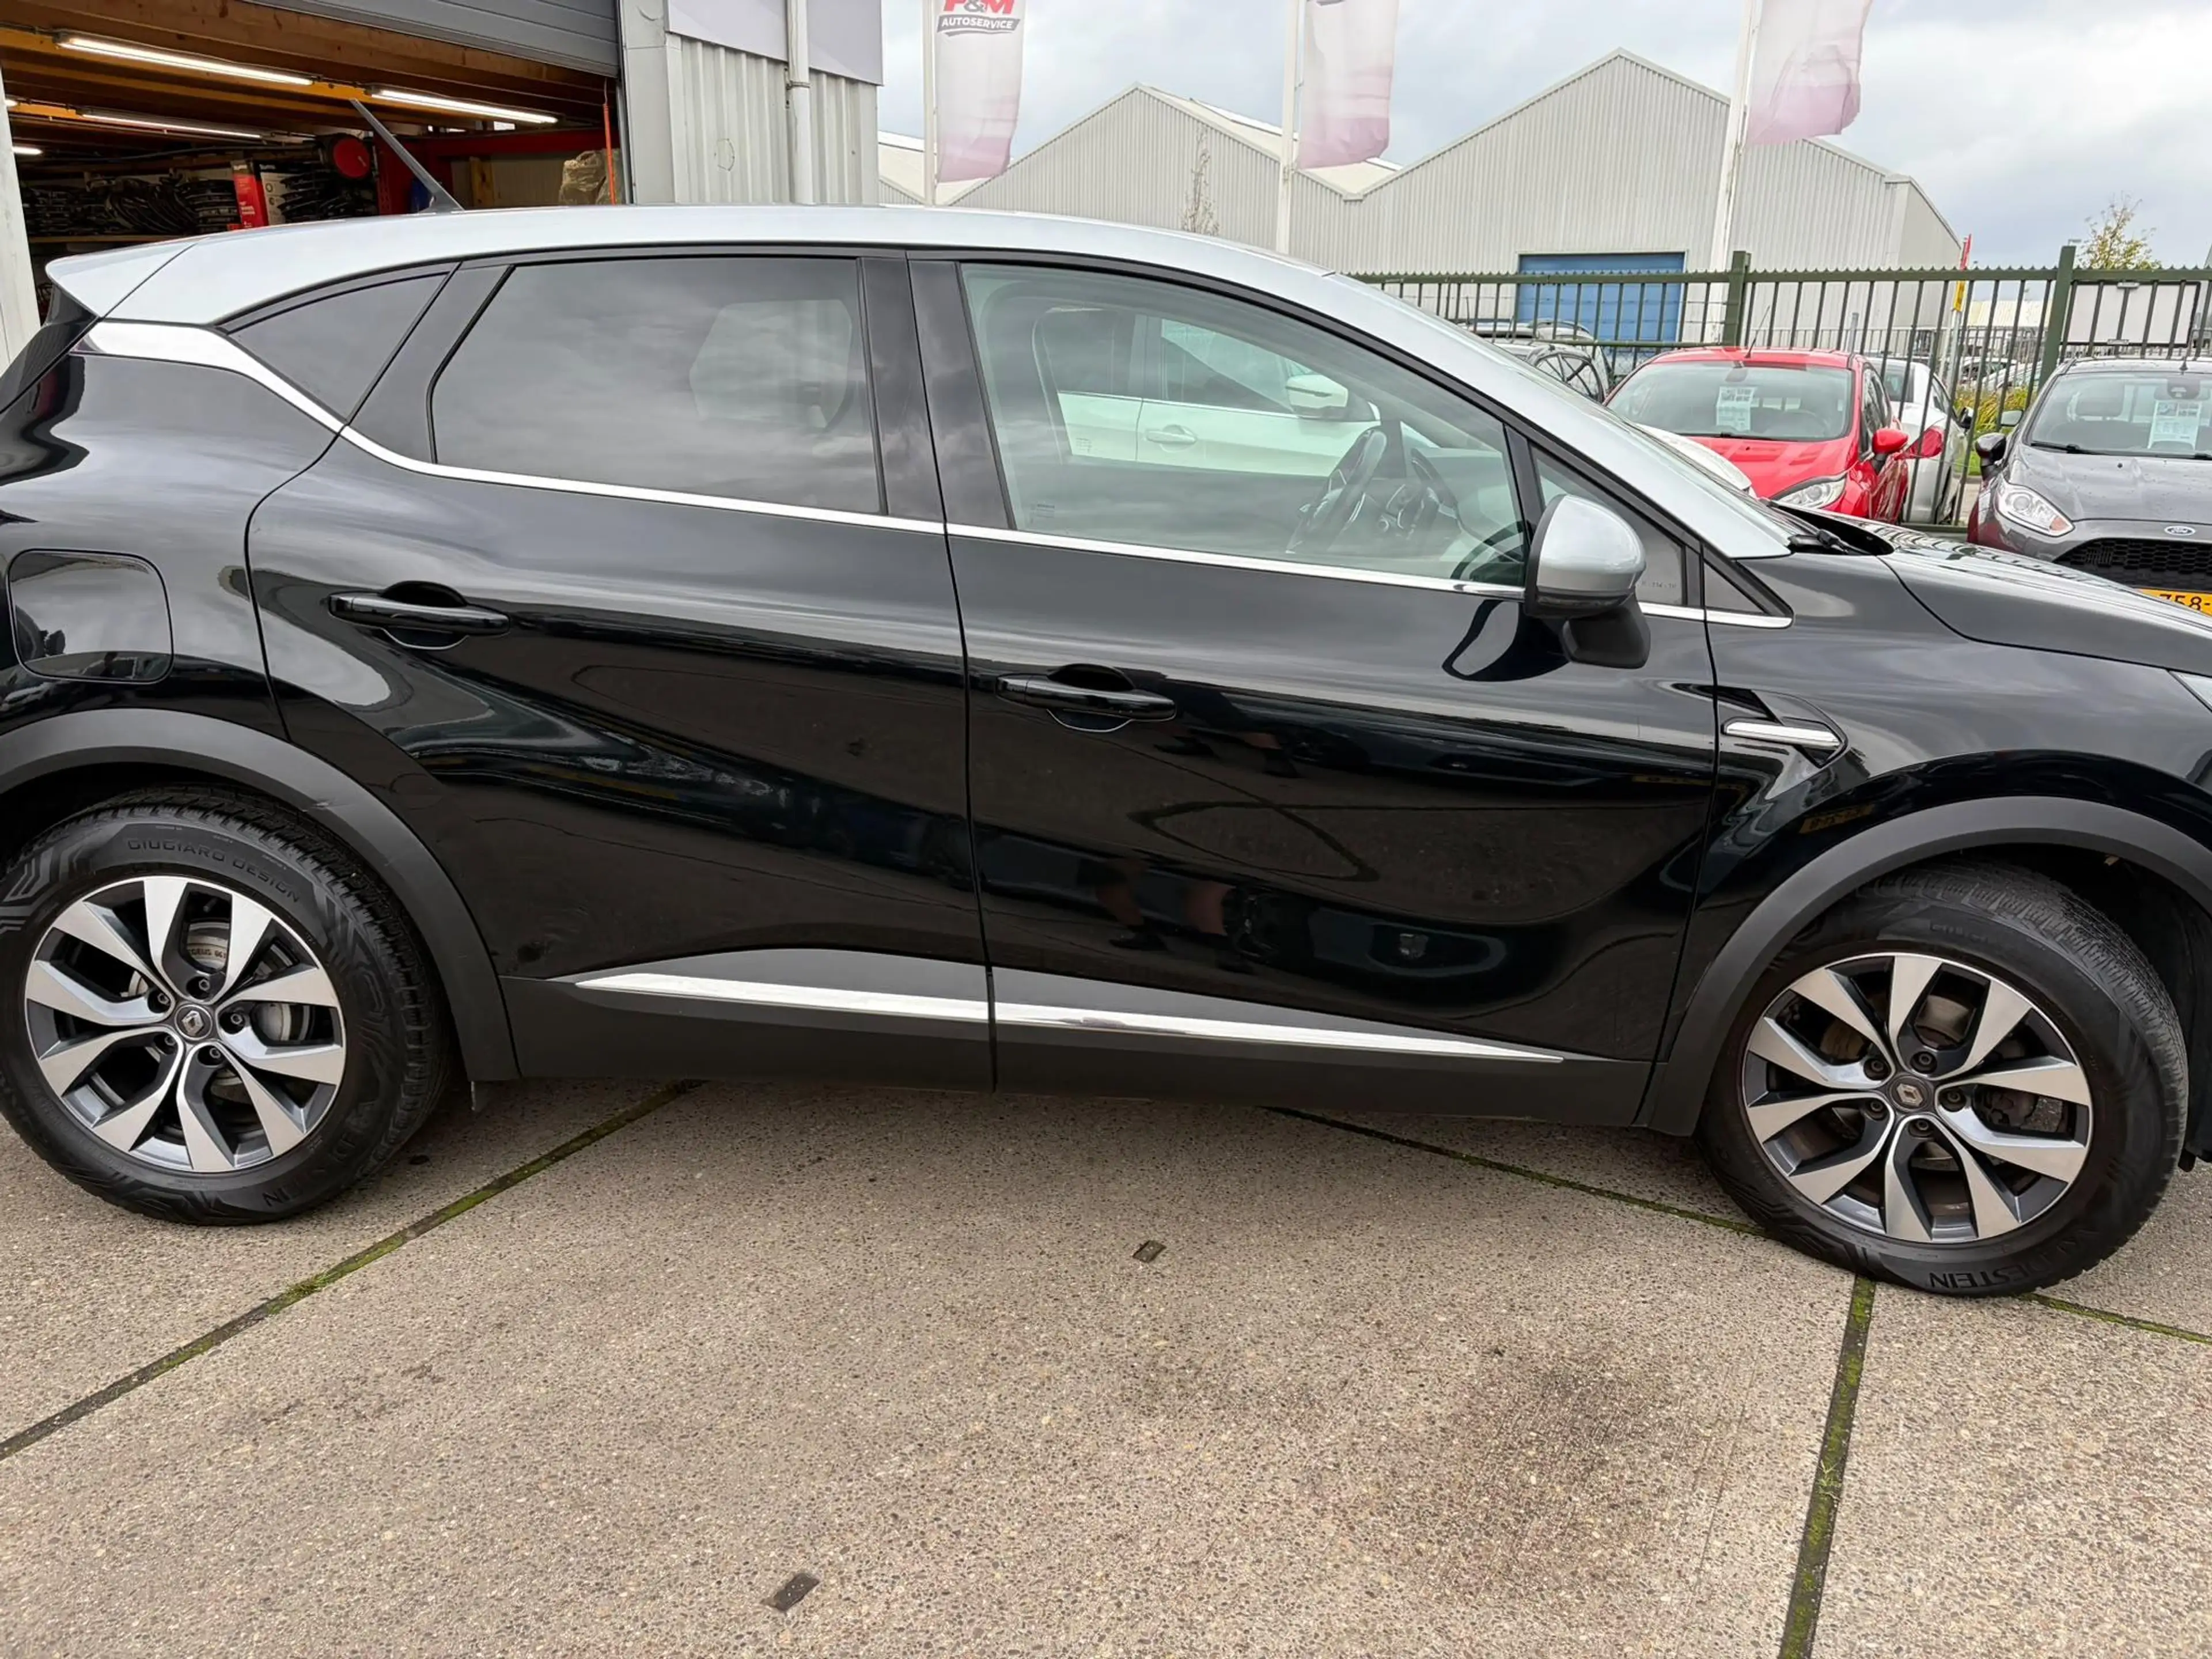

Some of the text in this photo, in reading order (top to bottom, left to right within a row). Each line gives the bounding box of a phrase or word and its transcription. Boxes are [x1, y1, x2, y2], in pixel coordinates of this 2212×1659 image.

[941, 16, 1014, 29] AUTOSERVICE
[127, 837, 300, 903] GIUGIARO DESIGN
